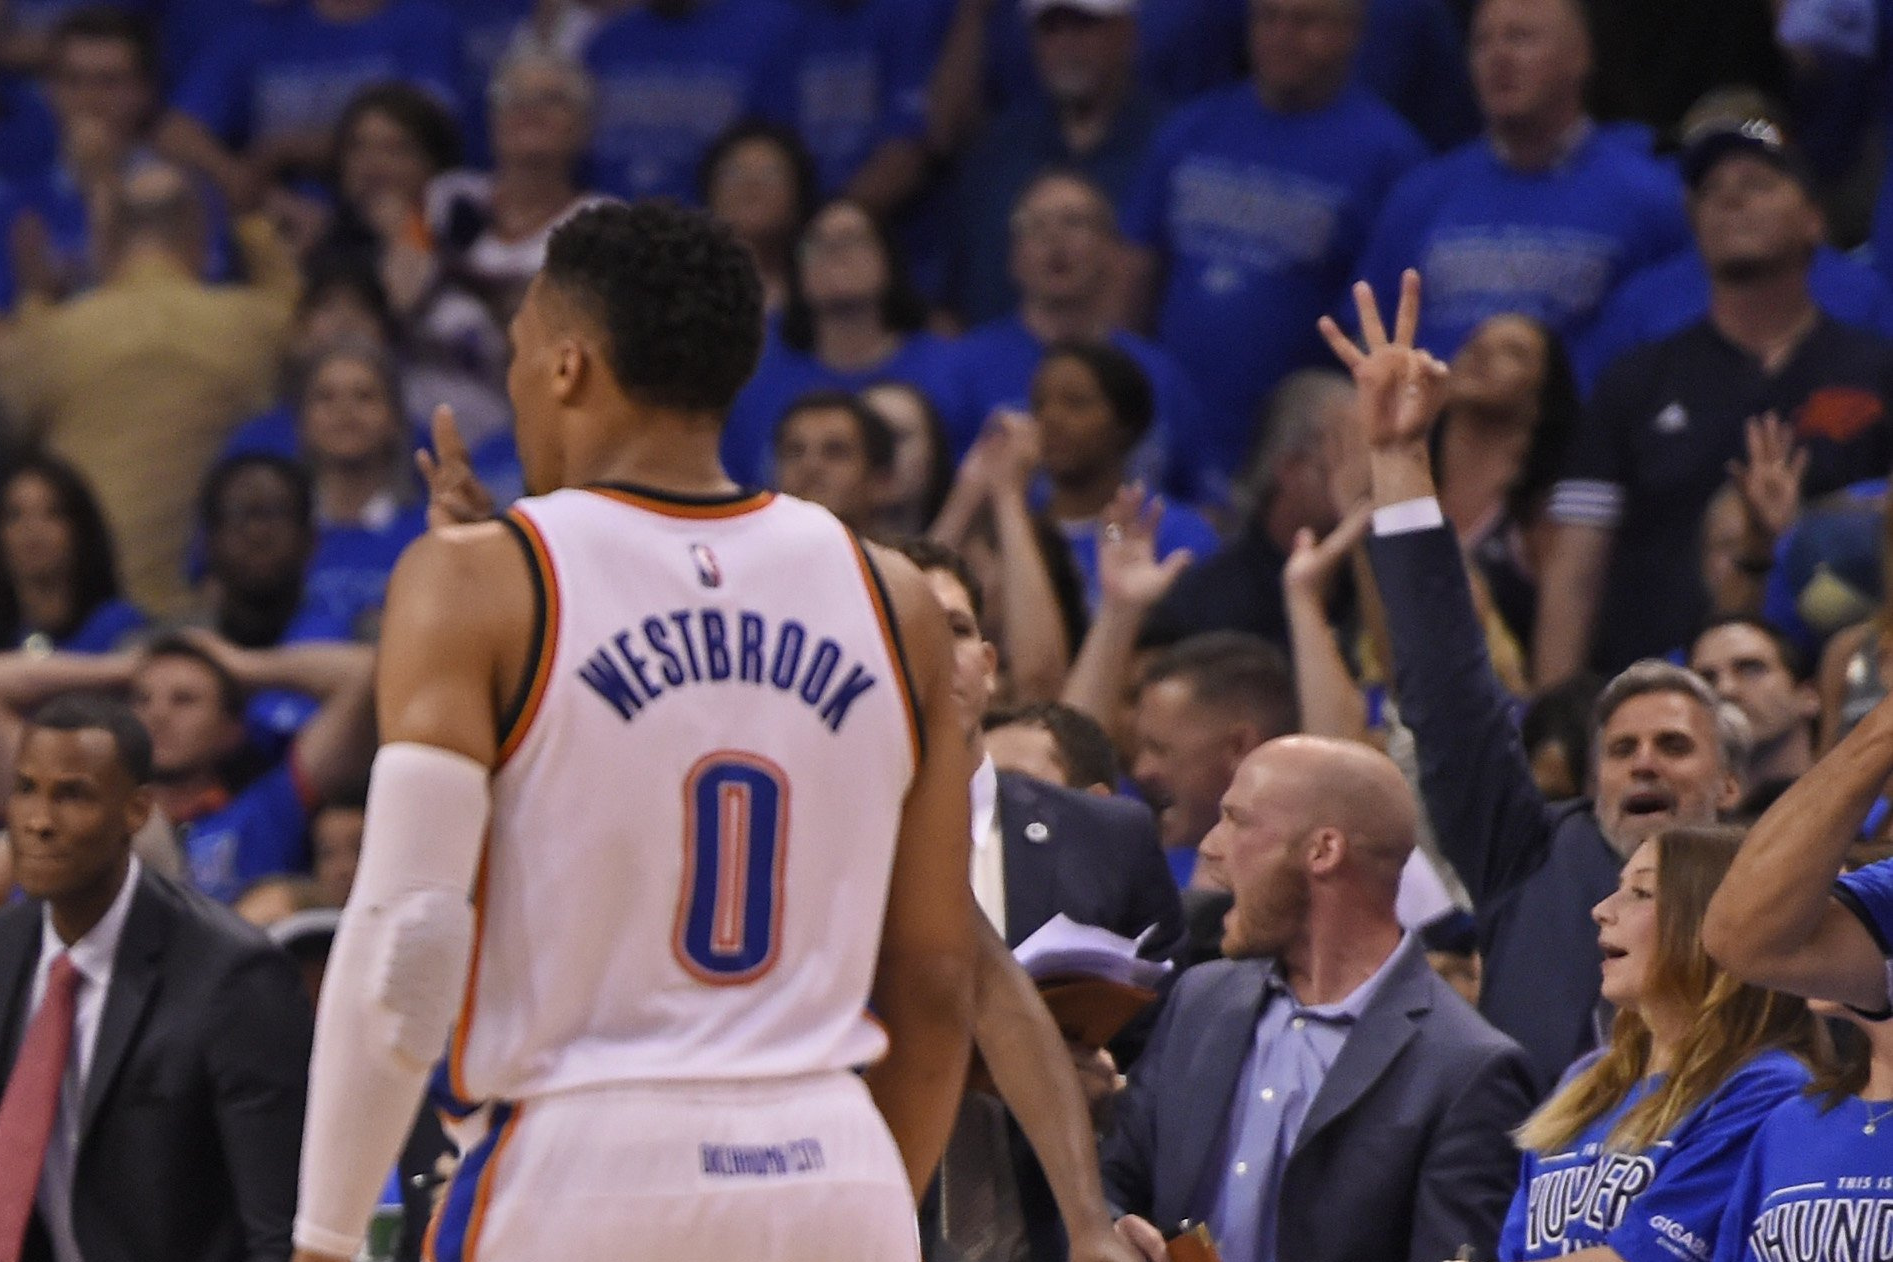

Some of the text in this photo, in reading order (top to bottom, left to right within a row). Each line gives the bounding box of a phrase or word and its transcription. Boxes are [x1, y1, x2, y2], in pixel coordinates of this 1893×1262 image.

[577, 608, 875, 734] WESTBROOK
[670, 748, 792, 987] 0
[1838, 1176, 1872, 1190] THIS
